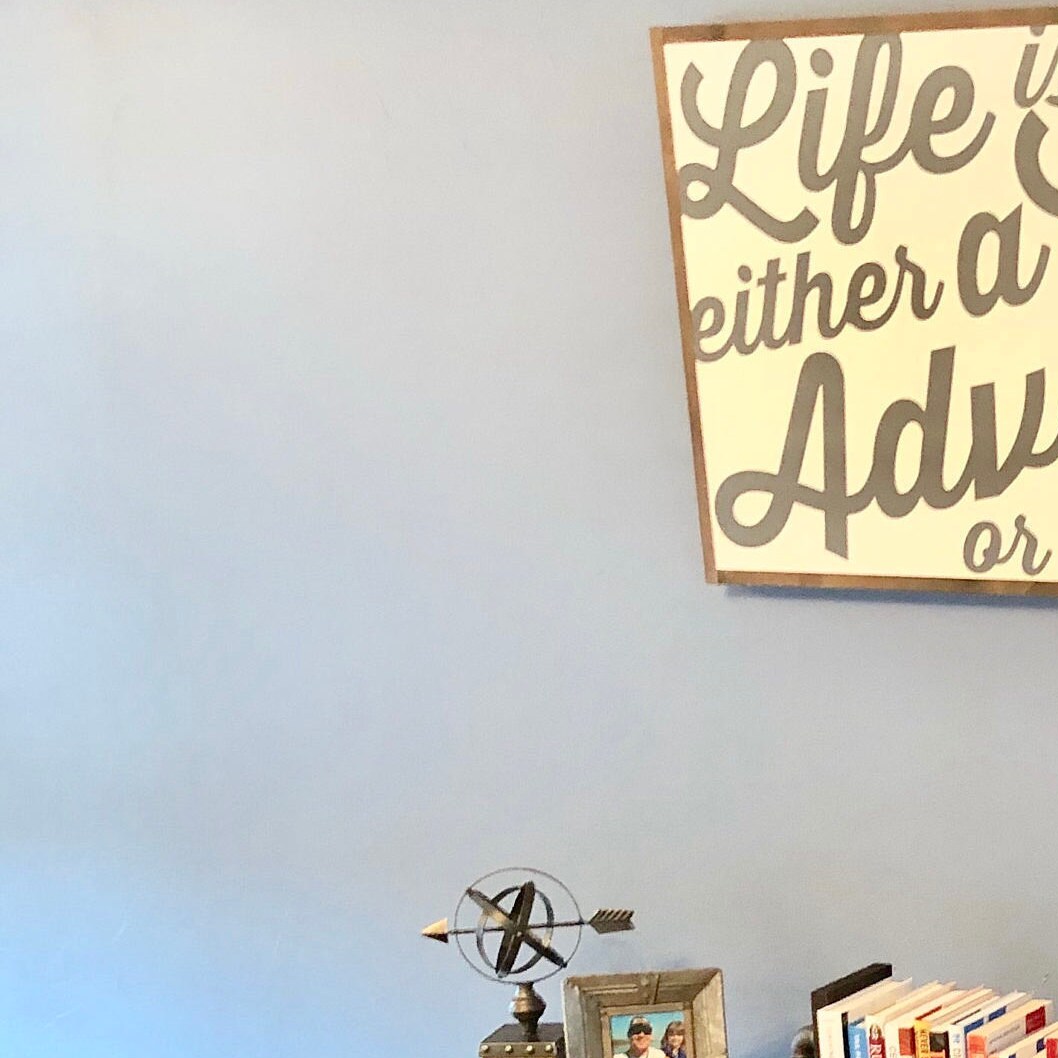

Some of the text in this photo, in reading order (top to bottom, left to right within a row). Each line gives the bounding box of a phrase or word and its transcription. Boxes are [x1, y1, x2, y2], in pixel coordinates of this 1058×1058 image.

[679, 33, 997, 246] Life
[692, 244, 944, 362] either
[956, 202, 1051, 318] a
[962, 514, 1053, 576] or
[919, 1029, 929, 1053] NEVER
